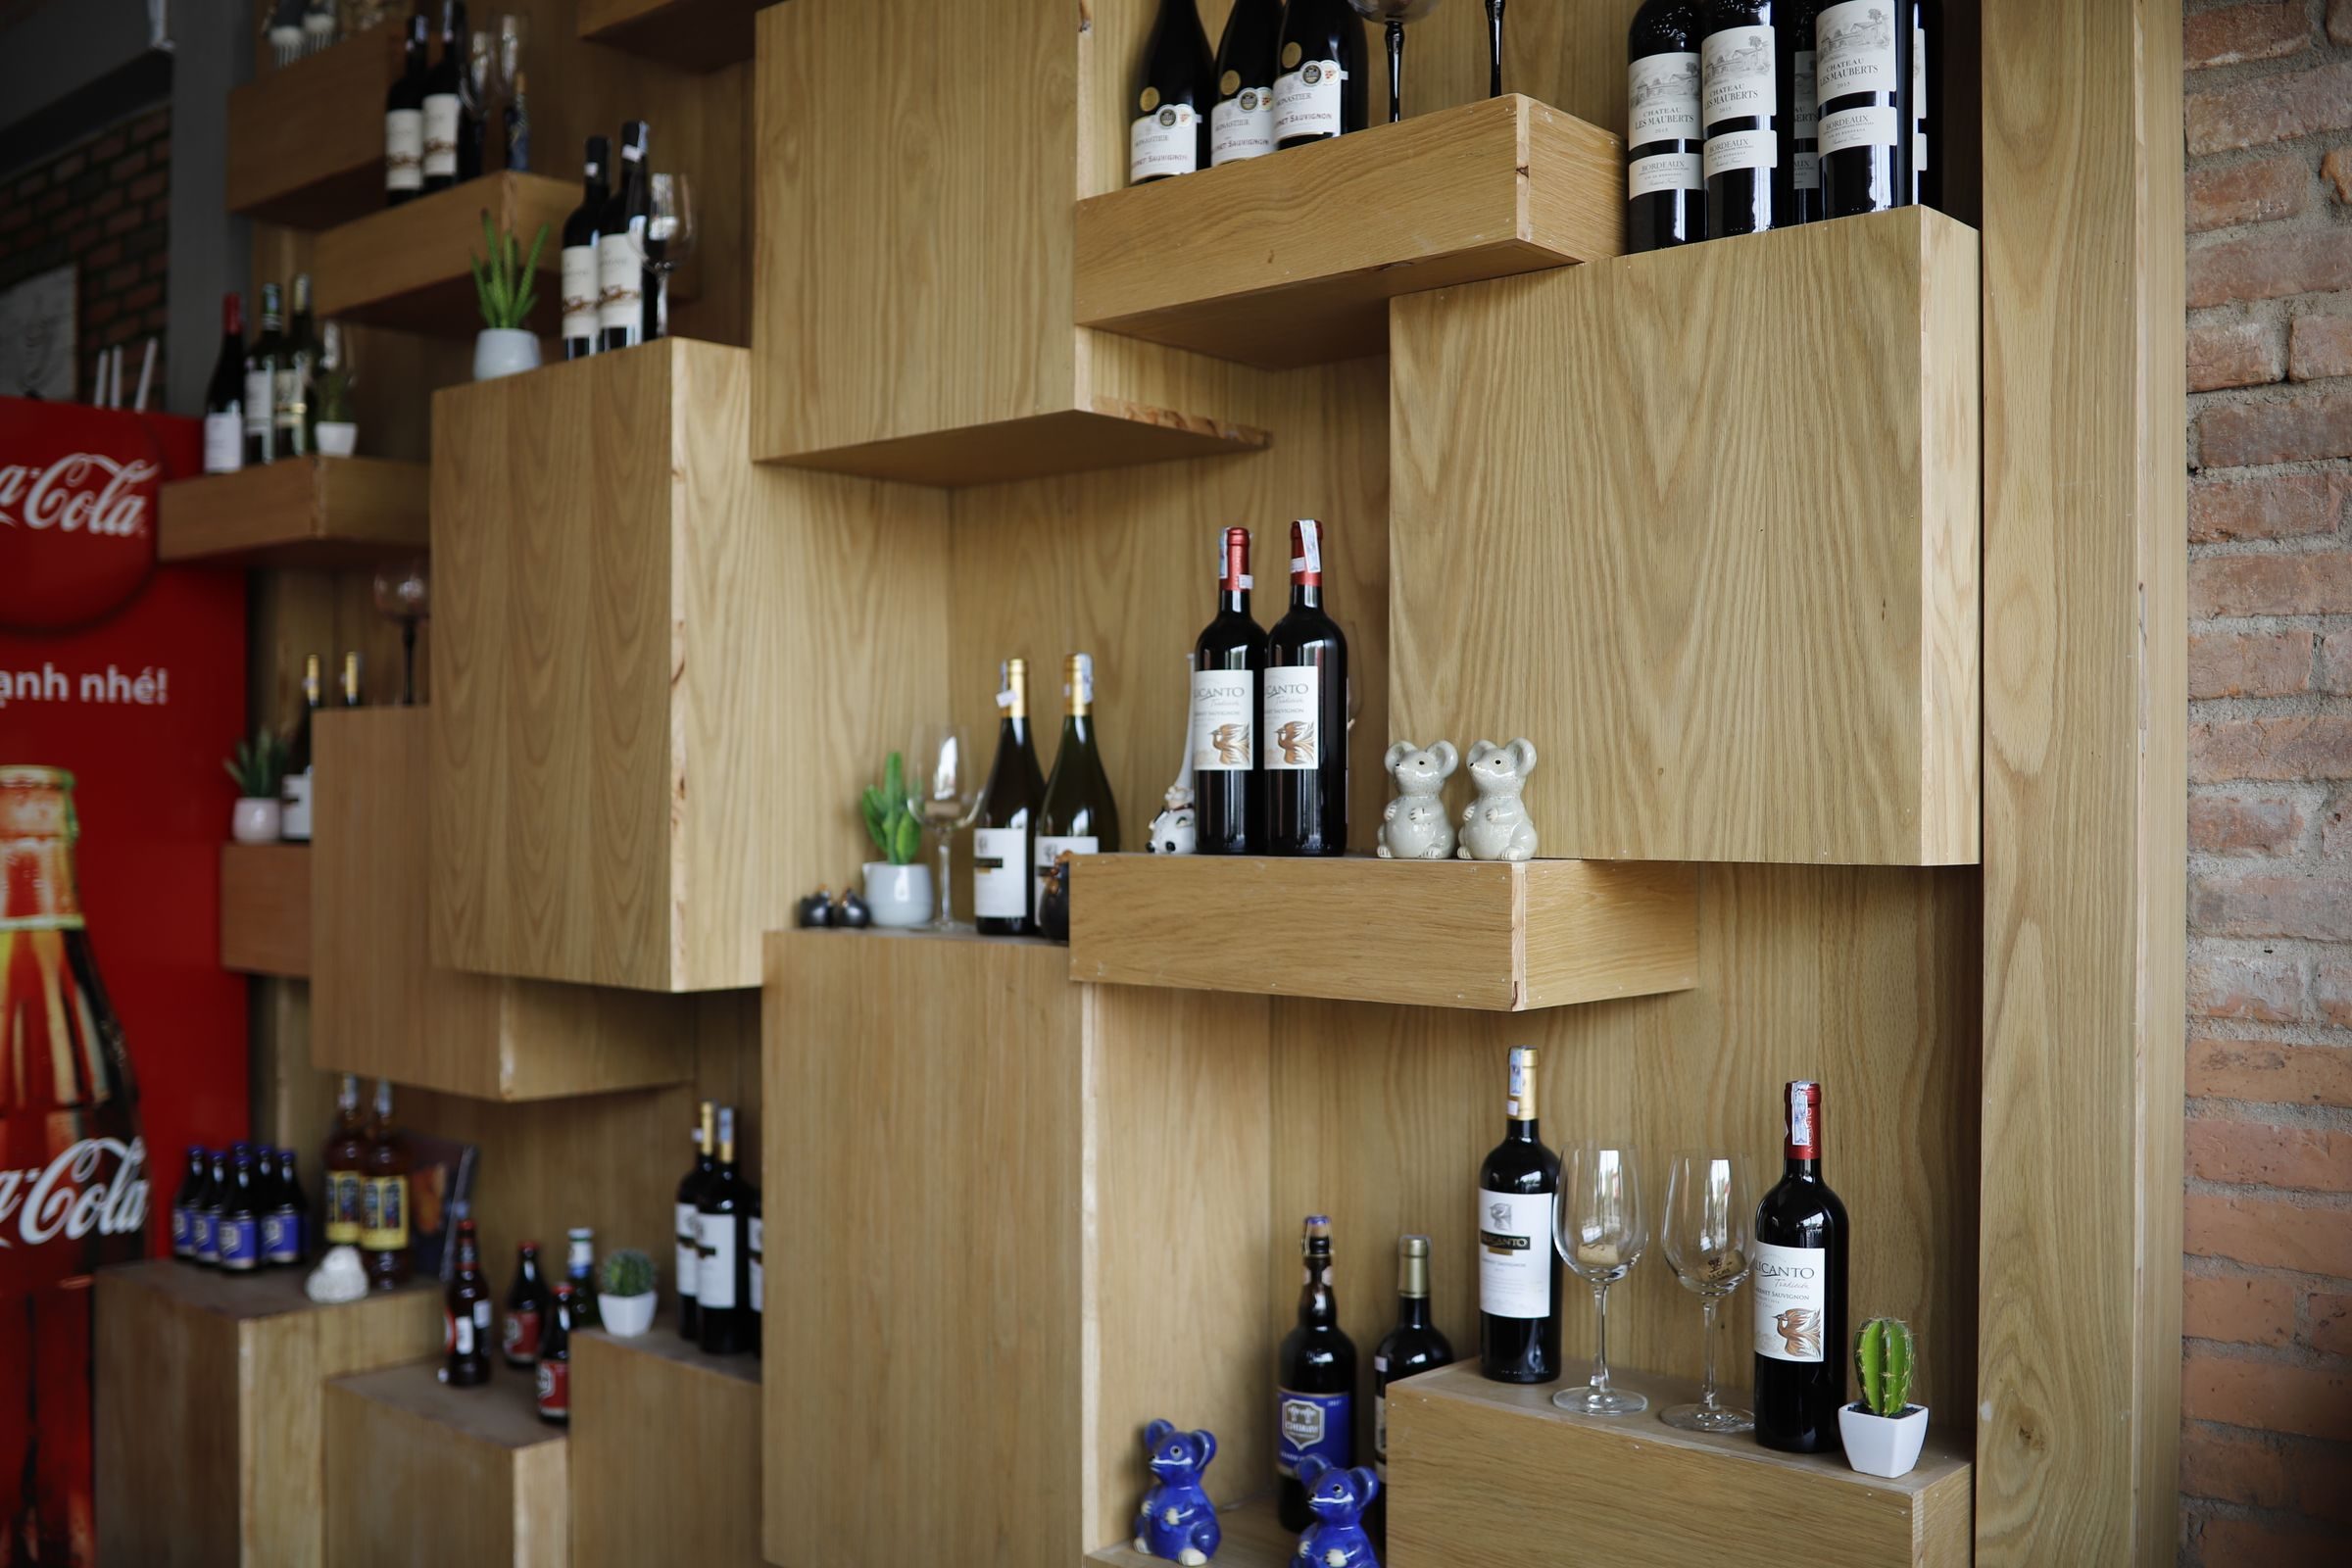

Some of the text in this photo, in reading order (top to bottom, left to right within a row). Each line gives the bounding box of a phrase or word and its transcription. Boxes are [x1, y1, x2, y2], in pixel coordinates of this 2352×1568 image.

[1826, 58, 1864, 73] CHATEAU
[1831, 64, 1879, 81] MAUBERTS
[1709, 83, 1744, 97] CHATEAU
[1713, 90, 1758, 107] MAUBERTS
[1643, 107, 1682, 118] CHATEAU
[1647, 114, 1694, 126] MAUBERTS
[1826, 115, 1869, 130] BORDEAUX
[1709, 139, 1749, 153] BORDEAUX
[1642, 160, 1686, 172] BORDEAUX
[79, 663, 169, 707] nhé!
[1771, 1291, 1810, 1300] SAUVIGNON
